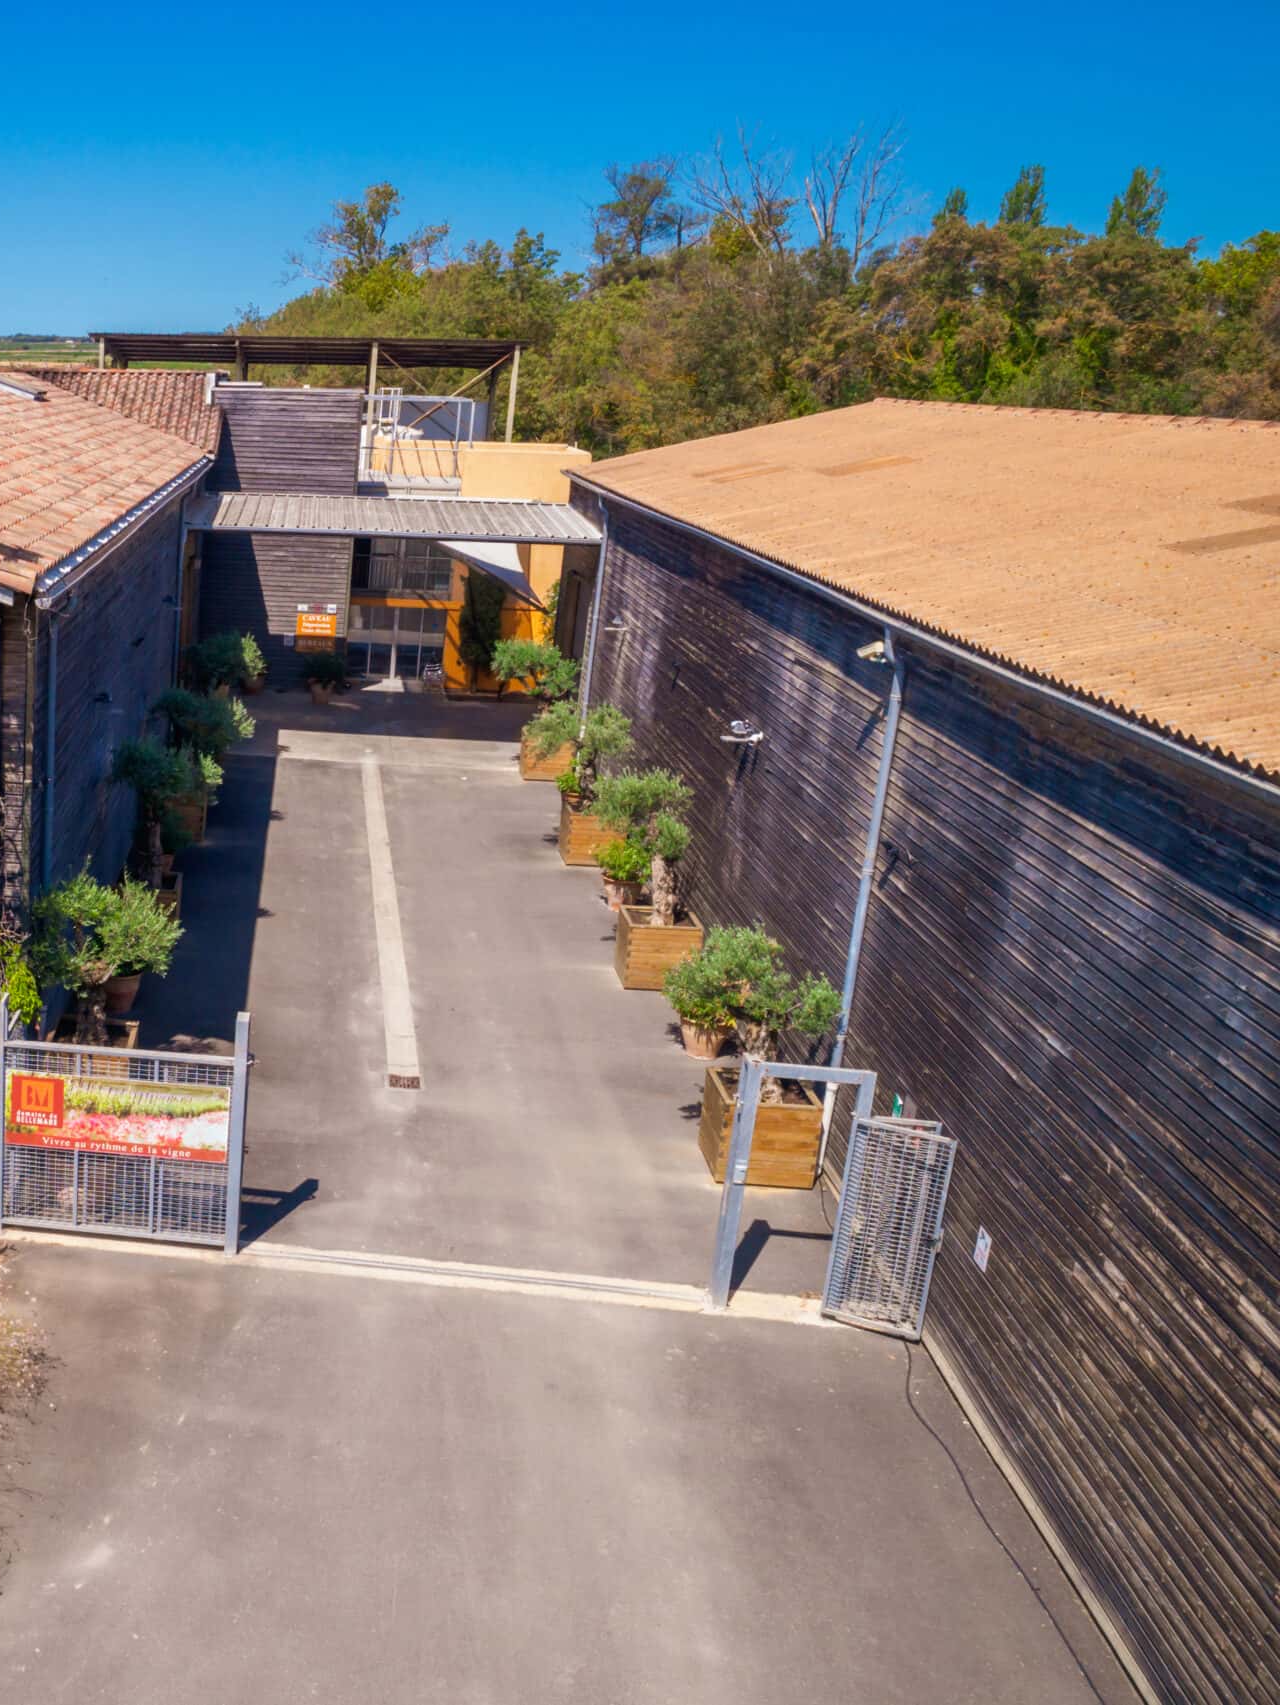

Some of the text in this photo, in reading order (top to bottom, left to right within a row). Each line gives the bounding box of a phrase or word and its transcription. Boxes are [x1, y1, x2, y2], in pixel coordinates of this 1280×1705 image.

[42, 1136, 192, 1159] Vivre au rythme de la vigne
